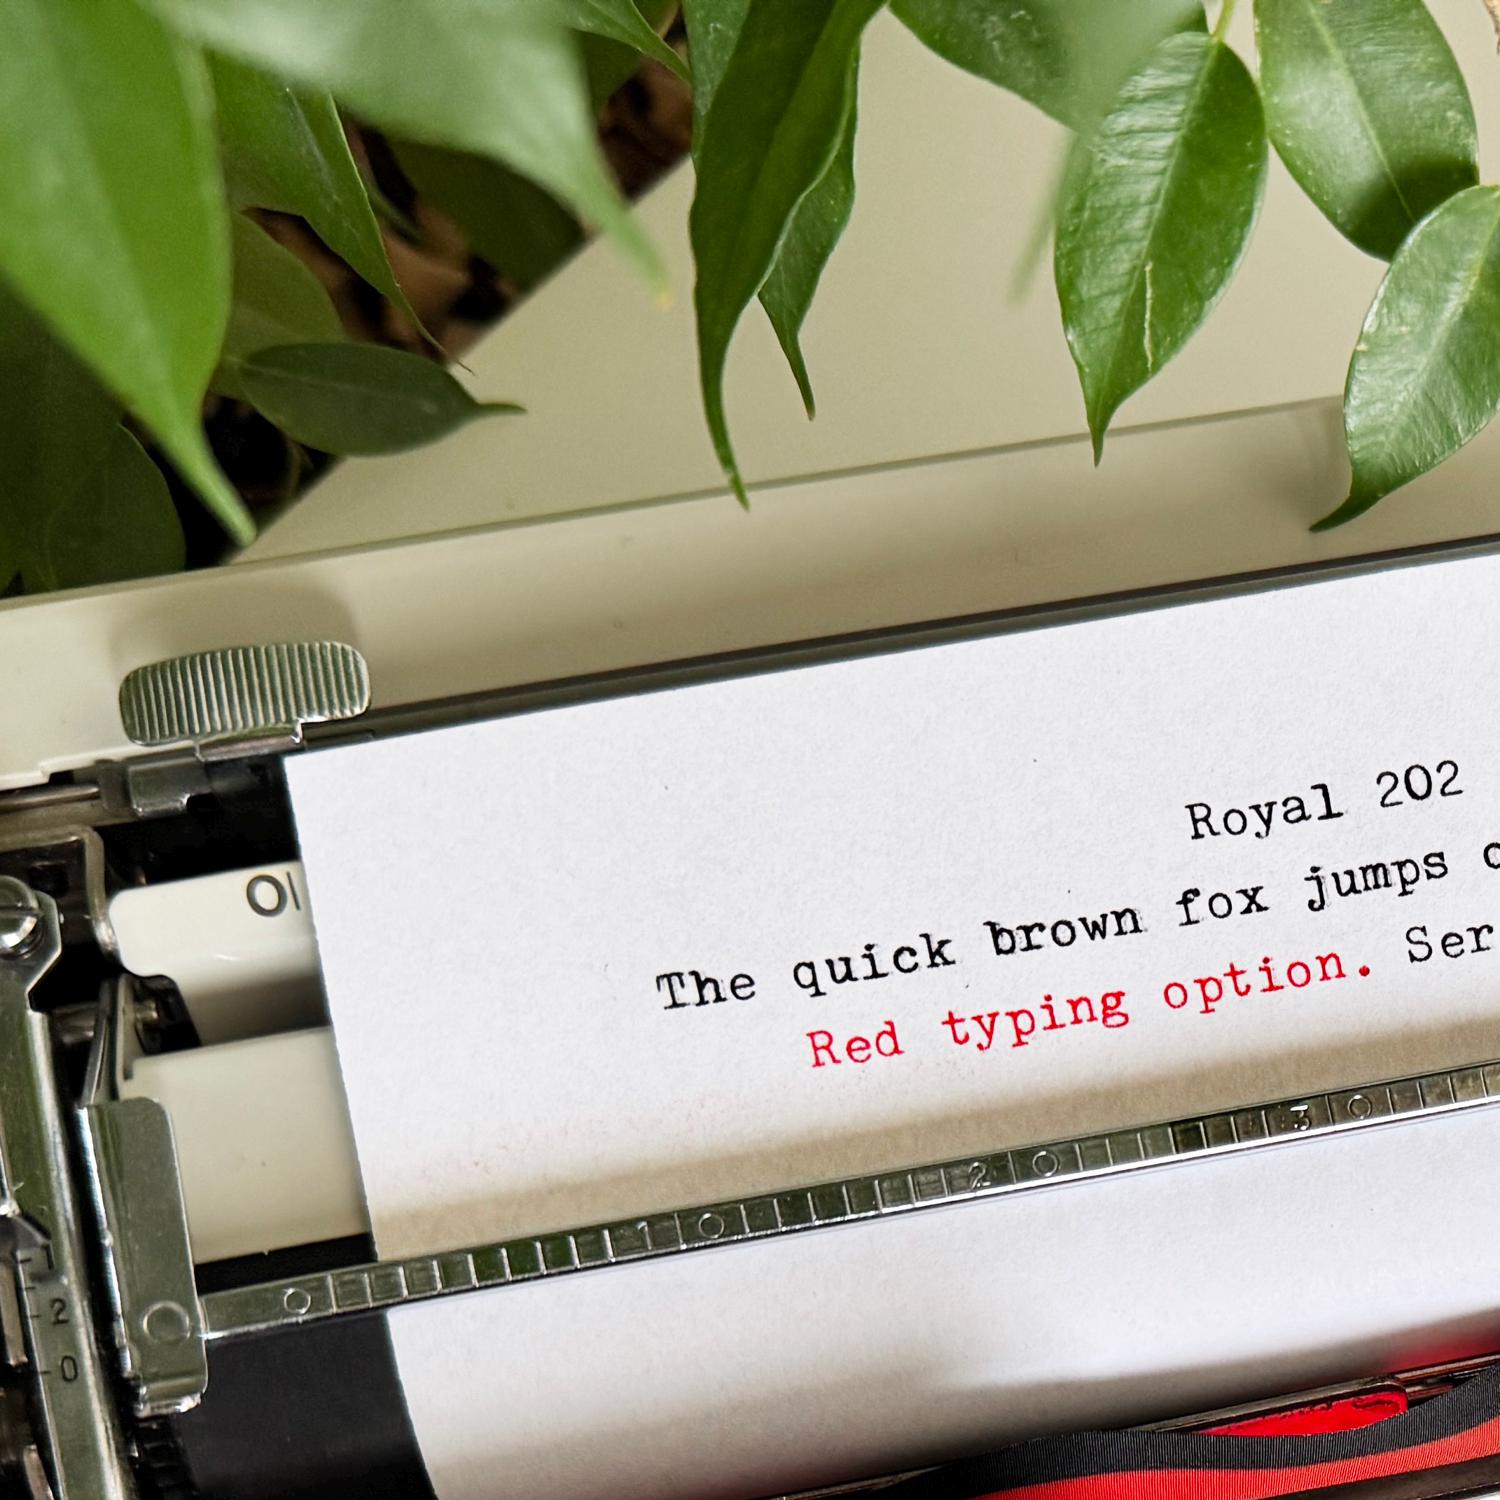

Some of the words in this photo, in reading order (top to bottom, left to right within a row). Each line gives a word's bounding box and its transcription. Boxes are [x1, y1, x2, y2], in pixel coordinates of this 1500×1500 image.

[1185, 783, 1344, 840] Royal
[1376, 760, 1463, 808] 202
[656, 970, 755, 1010] The
[793, 933, 956, 997] quick
[983, 908, 1143, 956] brown
[1176, 886, 1269, 926] fox
[1304, 852, 1448, 912] jumps
[806, 1020, 904, 1068] Red
[941, 991, 1129, 1051] typing
[1164, 953, 1370, 1014] option.
